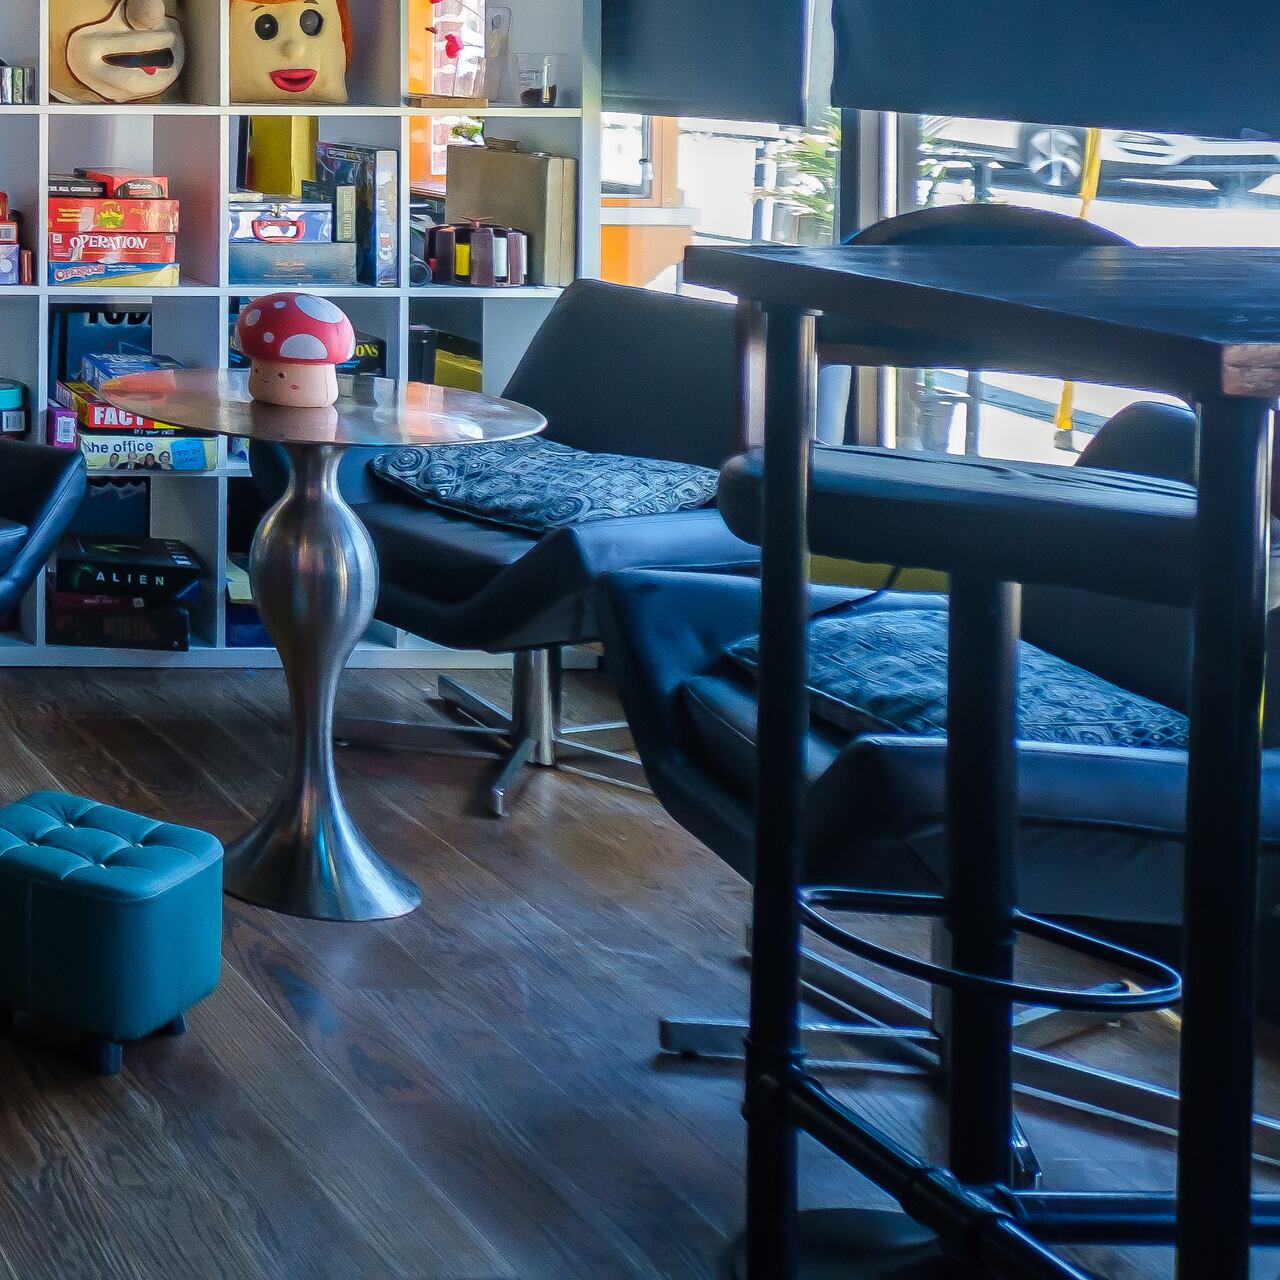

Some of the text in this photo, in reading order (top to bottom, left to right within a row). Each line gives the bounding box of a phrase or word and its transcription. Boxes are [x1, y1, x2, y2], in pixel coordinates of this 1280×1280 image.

[69, 234, 149, 250] OPERATION
[113, 439, 154, 454] office
[95, 570, 165, 587] ALIEN
